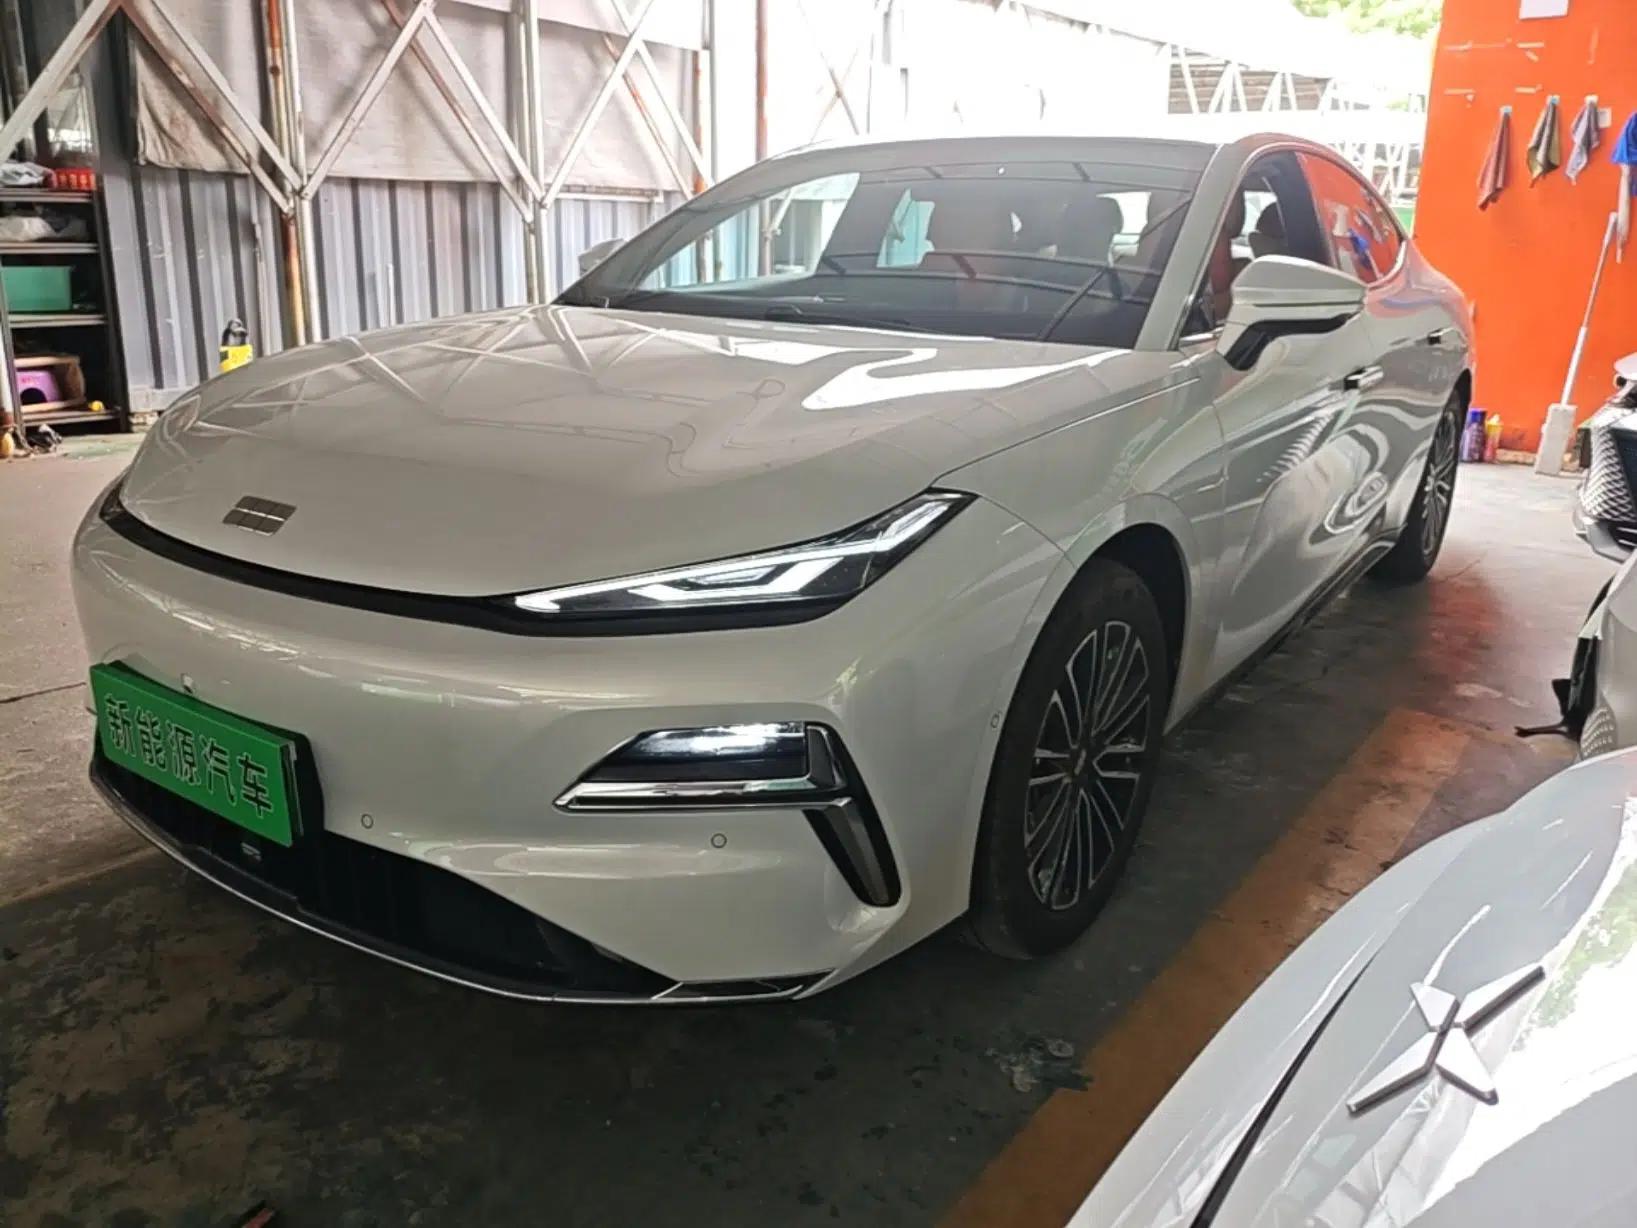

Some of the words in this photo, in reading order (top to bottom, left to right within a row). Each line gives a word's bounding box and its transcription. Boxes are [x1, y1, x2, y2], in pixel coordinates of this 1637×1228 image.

[105, 694, 273, 818] 新能源汽车
